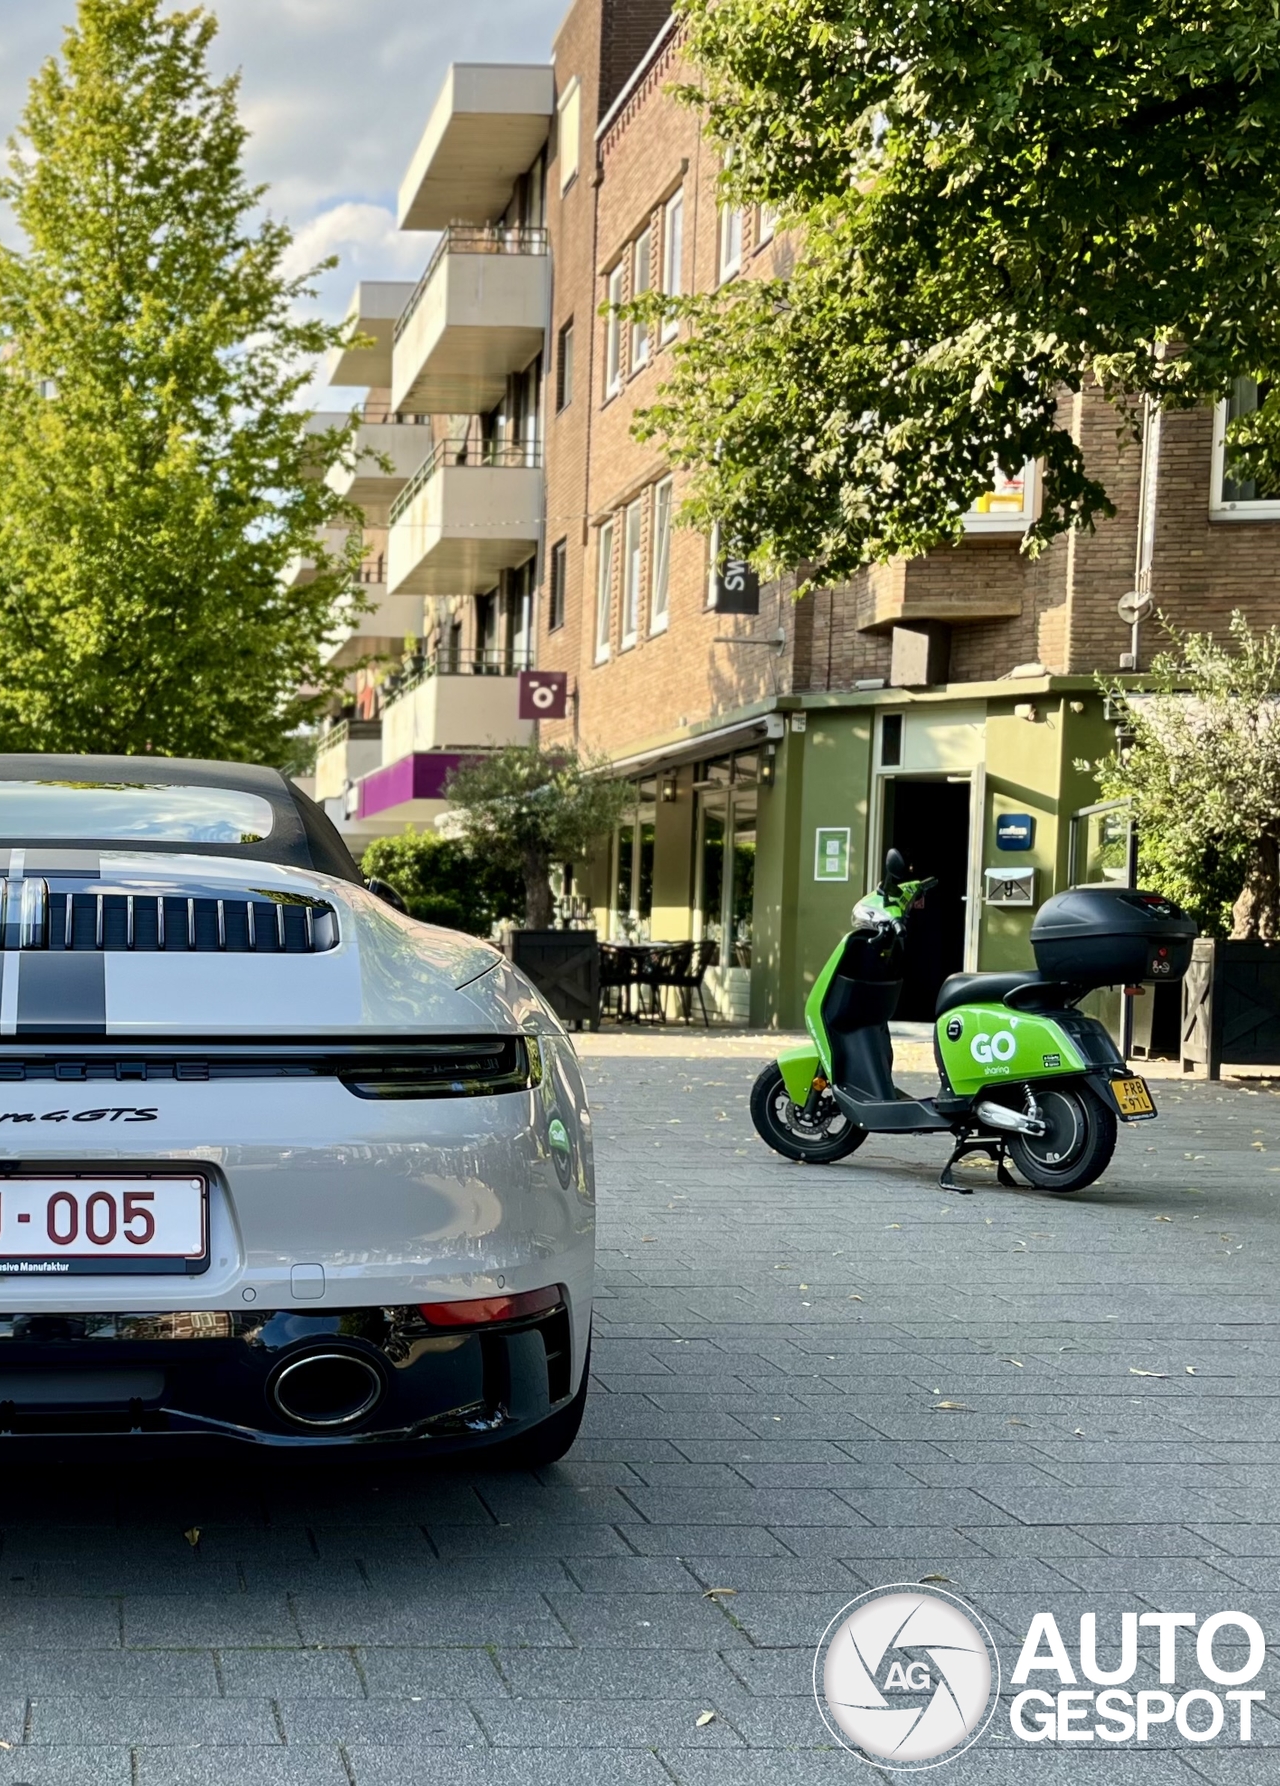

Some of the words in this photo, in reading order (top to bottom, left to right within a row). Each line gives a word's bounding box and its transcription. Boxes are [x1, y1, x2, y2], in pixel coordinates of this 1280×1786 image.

[970, 1030, 1016, 1064] GO
[984, 1065, 1010, 1075] sharing
[1123, 1081, 1144, 1096] FRB
[40, 1109, 70, 1123] 4
[71, 1107, 159, 1122] GTS
[20, 1262, 70, 1272] Manufaktur
